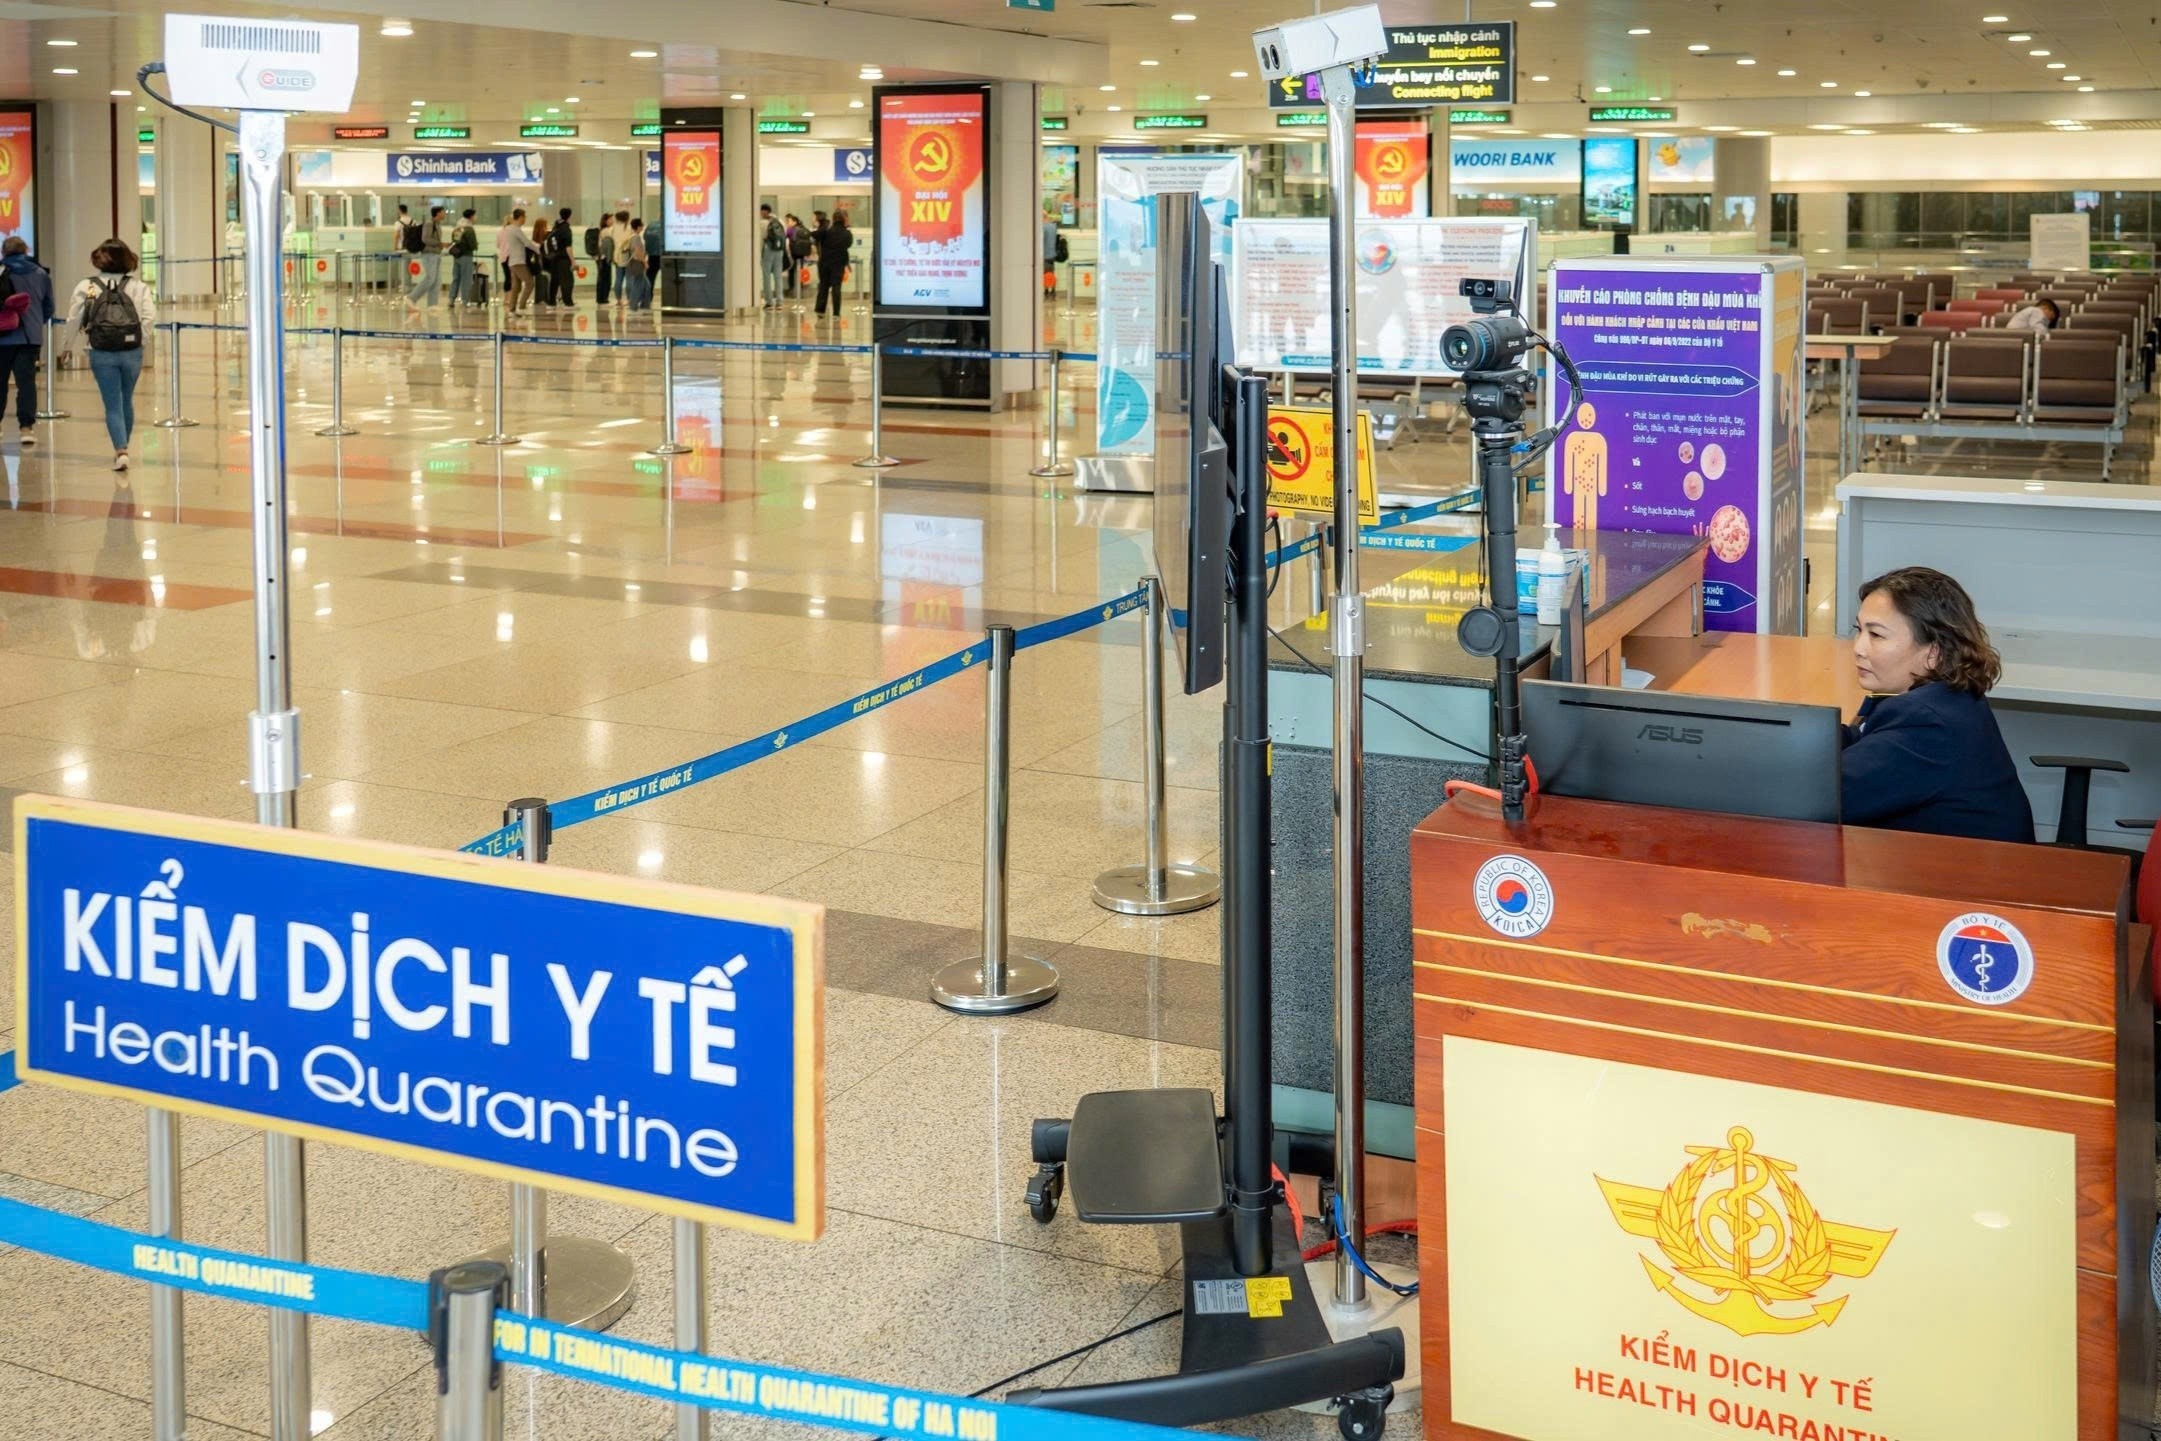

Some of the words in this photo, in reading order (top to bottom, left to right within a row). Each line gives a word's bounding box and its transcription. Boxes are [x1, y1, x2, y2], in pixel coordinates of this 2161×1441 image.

[1429, 46, 1500, 60] Immigration
[261, 72, 310, 87] GUIDE
[1410, 71, 1433, 84] bay
[1392, 86, 1460, 99] Connecting
[1461, 84, 1493, 99] flight
[414, 158, 463, 174] Shinhan
[465, 158, 497, 174] Bank
[1454, 152, 1508, 167] WOORI
[1510, 151, 1557, 167] BANK
[681, 191, 704, 205] XIV
[1376, 191, 1406, 206] XIV
[912, 200, 953, 222] XIV
[914, 289, 932, 297] ACV
[1593, 287, 1611, 305] CÁO
[1613, 288, 1642, 305] PHÒNG
[1676, 289, 1700, 310] BỆNH
[1723, 291, 1744, 308] MÙA
[1741, 320, 1759, 331] NAM
[1648, 412, 1660, 420] ban
[1632, 435, 1645, 443] sinh
[1637, 724, 1704, 745] ASUS
[640, 784, 647, 797] Y
[648, 775, 661, 795] TẾ
[683, 763, 695, 783] TẾ
[1479, 860, 1508, 908] REPUBLIC
[1512, 862, 1528, 874] OF
[1529, 874, 1547, 916] KOREA
[1493, 914, 1535, 933] KOICA
[63, 858, 257, 1001] KIỂM
[287, 911, 510, 1046] DỊCH
[546, 962, 613, 1061] Y
[638, 953, 749, 1088] TẾ
[65, 1000, 279, 1091] Health
[302, 1044, 739, 1178] Quarantine
[133, 1243, 199, 1280] HEALTH
[201, 1257, 315, 1301] QUARANTINE
[493, 1318, 527, 1355] FOR
[679, 1361, 756, 1405] HEALTH
[758, 1374, 890, 1428] QUARANTINE
[892, 1396, 922, 1432] OF
[1619, 1330, 1697, 1373] KIỂM
[1708, 1353, 1788, 1393] DỊCH
[1798, 1372, 1819, 1399] Y
[1829, 1376, 1874, 1413] TẾ
[1573, 1366, 1697, 1417] HEALTH
